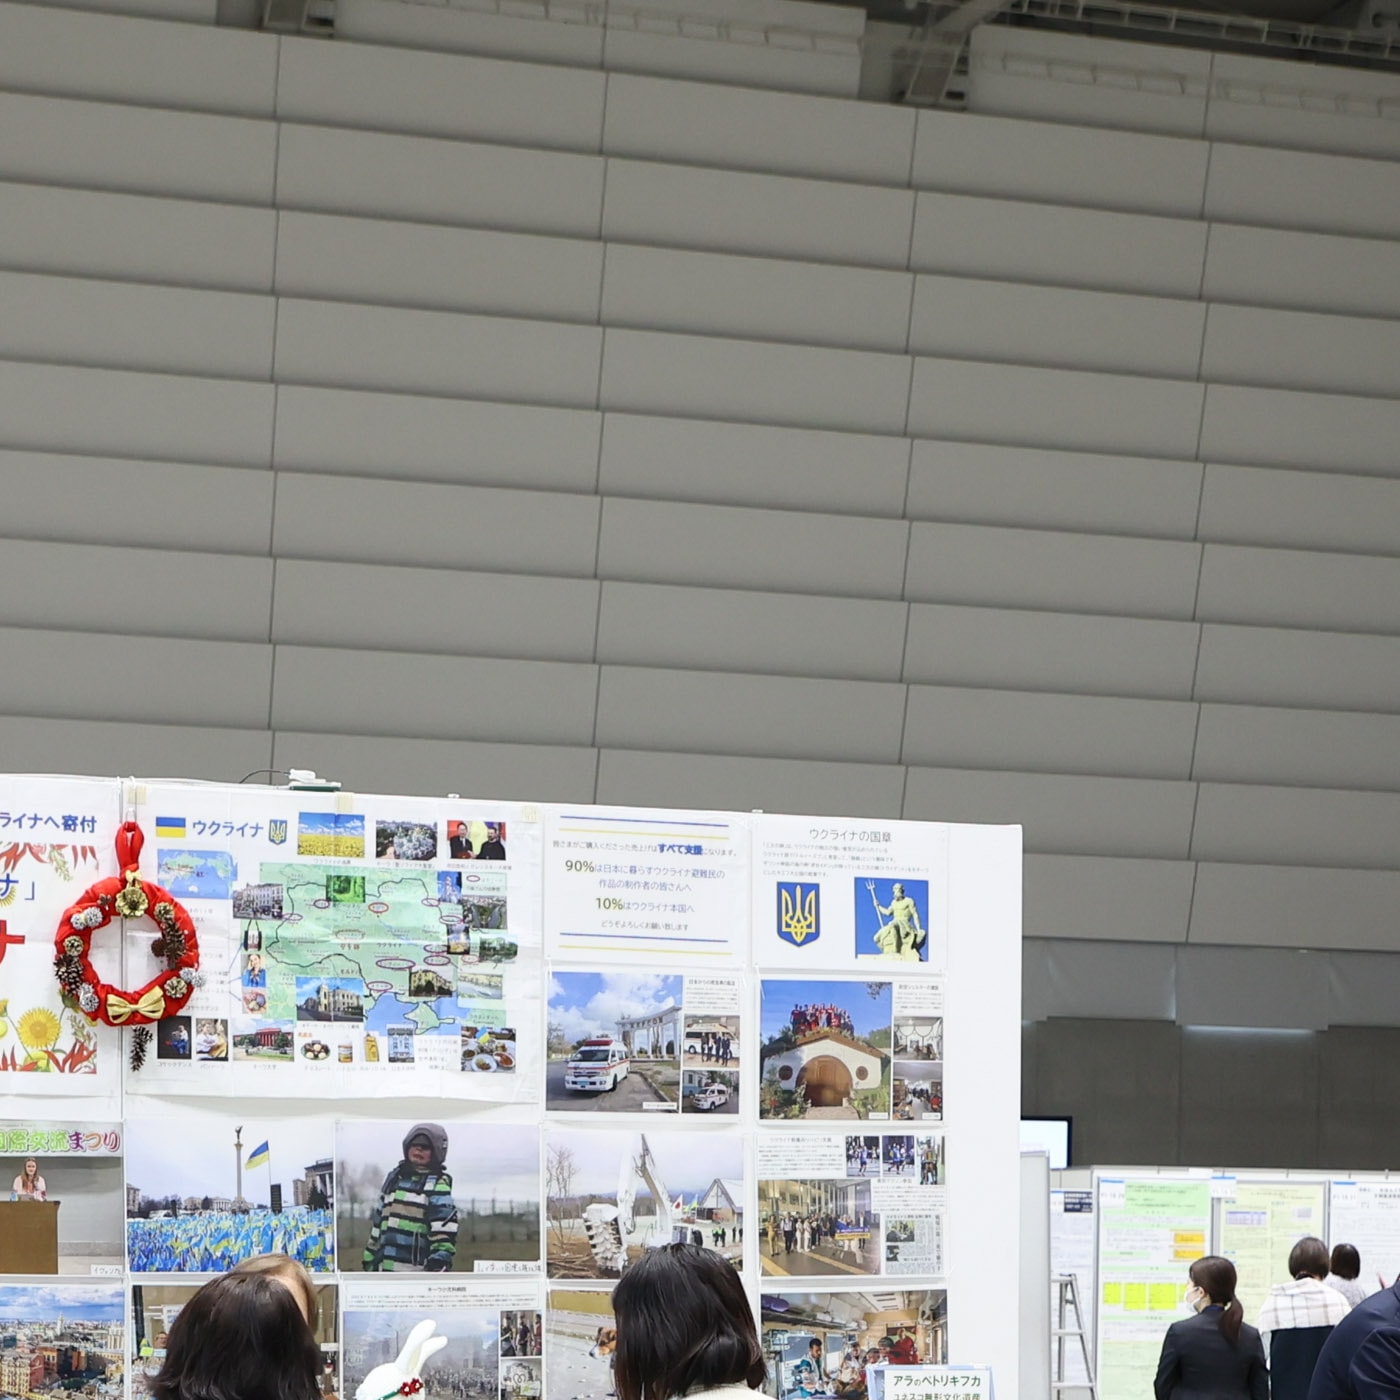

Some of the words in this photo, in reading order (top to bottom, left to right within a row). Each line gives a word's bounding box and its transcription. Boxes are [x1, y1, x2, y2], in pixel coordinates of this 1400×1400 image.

[192, 820, 264, 838] ウクライナ
[892, 1374, 982, 1389] アラのペトリキフカ
